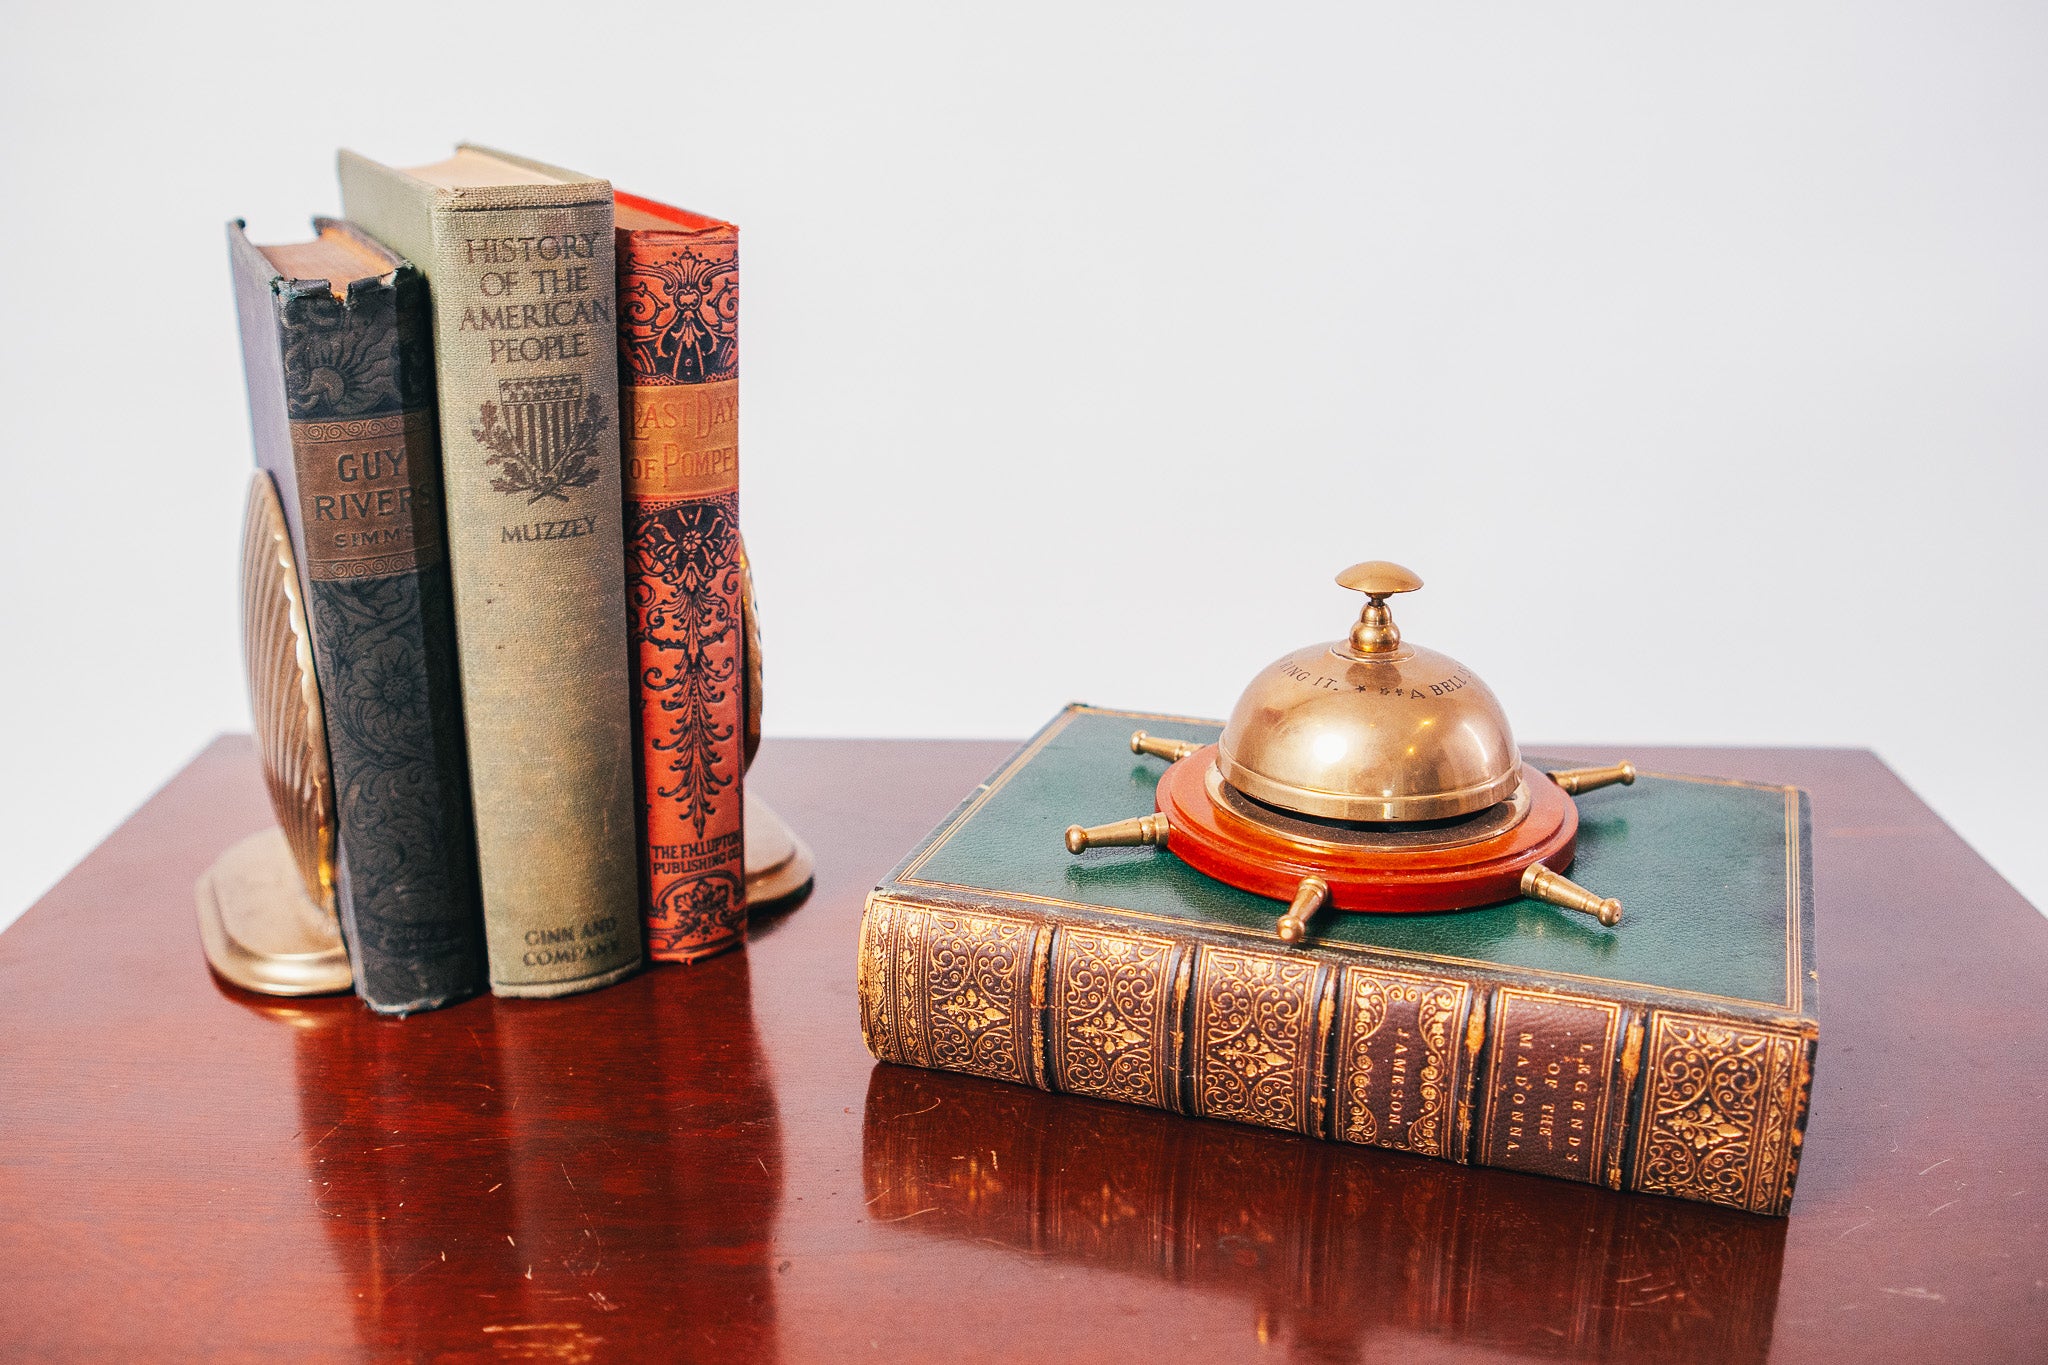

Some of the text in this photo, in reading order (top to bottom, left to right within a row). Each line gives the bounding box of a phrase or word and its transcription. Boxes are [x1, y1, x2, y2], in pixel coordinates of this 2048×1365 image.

[465, 232, 600, 264] HISTORY
[480, 266, 590, 297] OF THE
[458, 297, 612, 332] AMERICAN
[488, 333, 590, 363] PEOPLE
[694, 390, 739, 439] DAY
[337, 447, 406, 483] GUY
[631, 458, 660, 480] OF
[314, 483, 431, 522] RIVERS
[334, 524, 415, 549] SIMMS
[501, 515, 598, 543] MUZZEY
[1312, 676, 1339, 691] IT.
[1410, 688, 1426, 699] A
[1428, 674, 1467, 696] BELL
[652, 845, 679, 860] THE
[653, 851, 726, 875] PUBLISHING
[1388, 1027, 1410, 1129] JAMESON.
[1539, 1062, 1560, 1136] OF THE
[1565, 1042, 1594, 1162] LEGENDS
